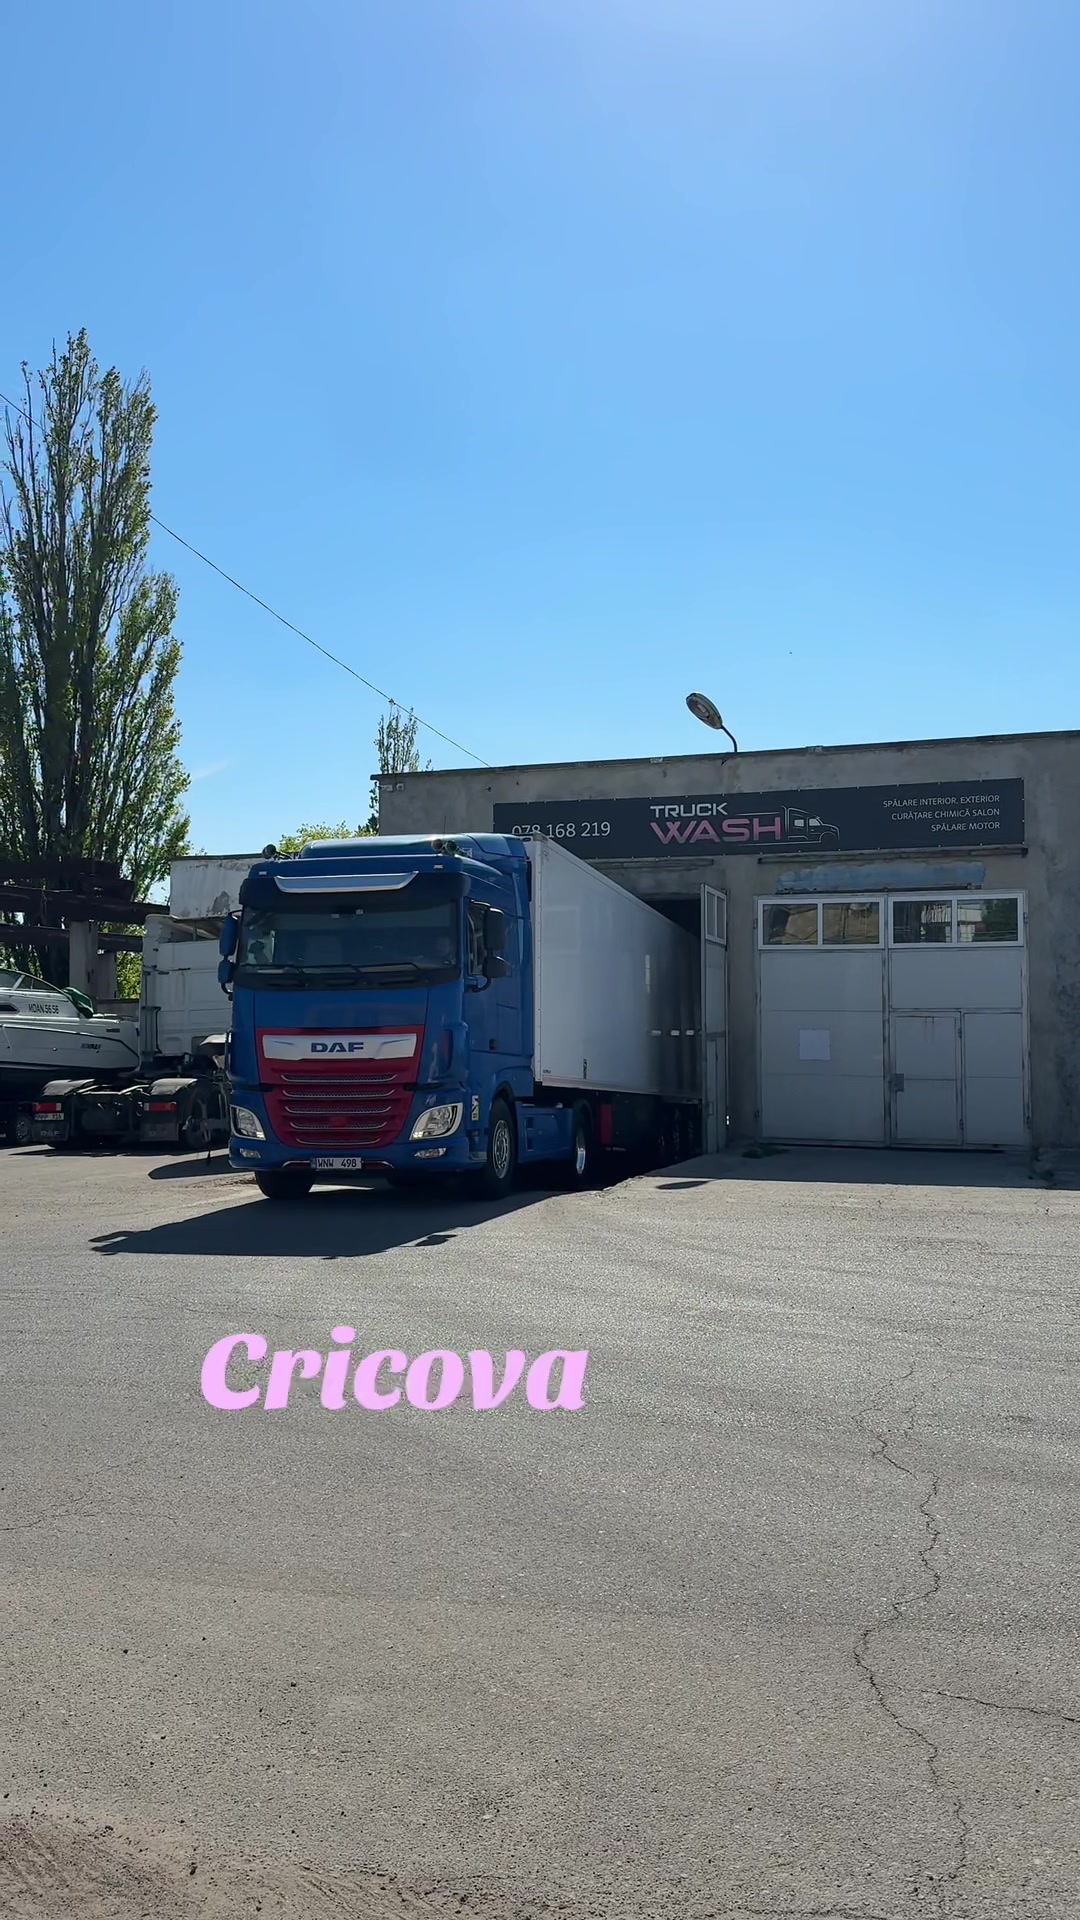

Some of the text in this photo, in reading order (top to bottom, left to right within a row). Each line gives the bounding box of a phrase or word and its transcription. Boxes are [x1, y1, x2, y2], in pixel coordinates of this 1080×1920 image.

[883, 798, 918, 808] SPĂLARE
[960, 795, 1000, 804] EXTERIOR
[650, 803, 728, 818] TRUCK
[934, 808, 971, 819] CHIMICĂ
[972, 808, 1000, 817] SALON
[546, 823, 576, 838] 168
[581, 821, 611, 837] 219
[650, 817, 781, 844] WASH
[931, 821, 1000, 832] SPĂLARE MOTOR
[311, 1042, 364, 1053] DAF
[317, 1158, 357, 1168] WNW 498
